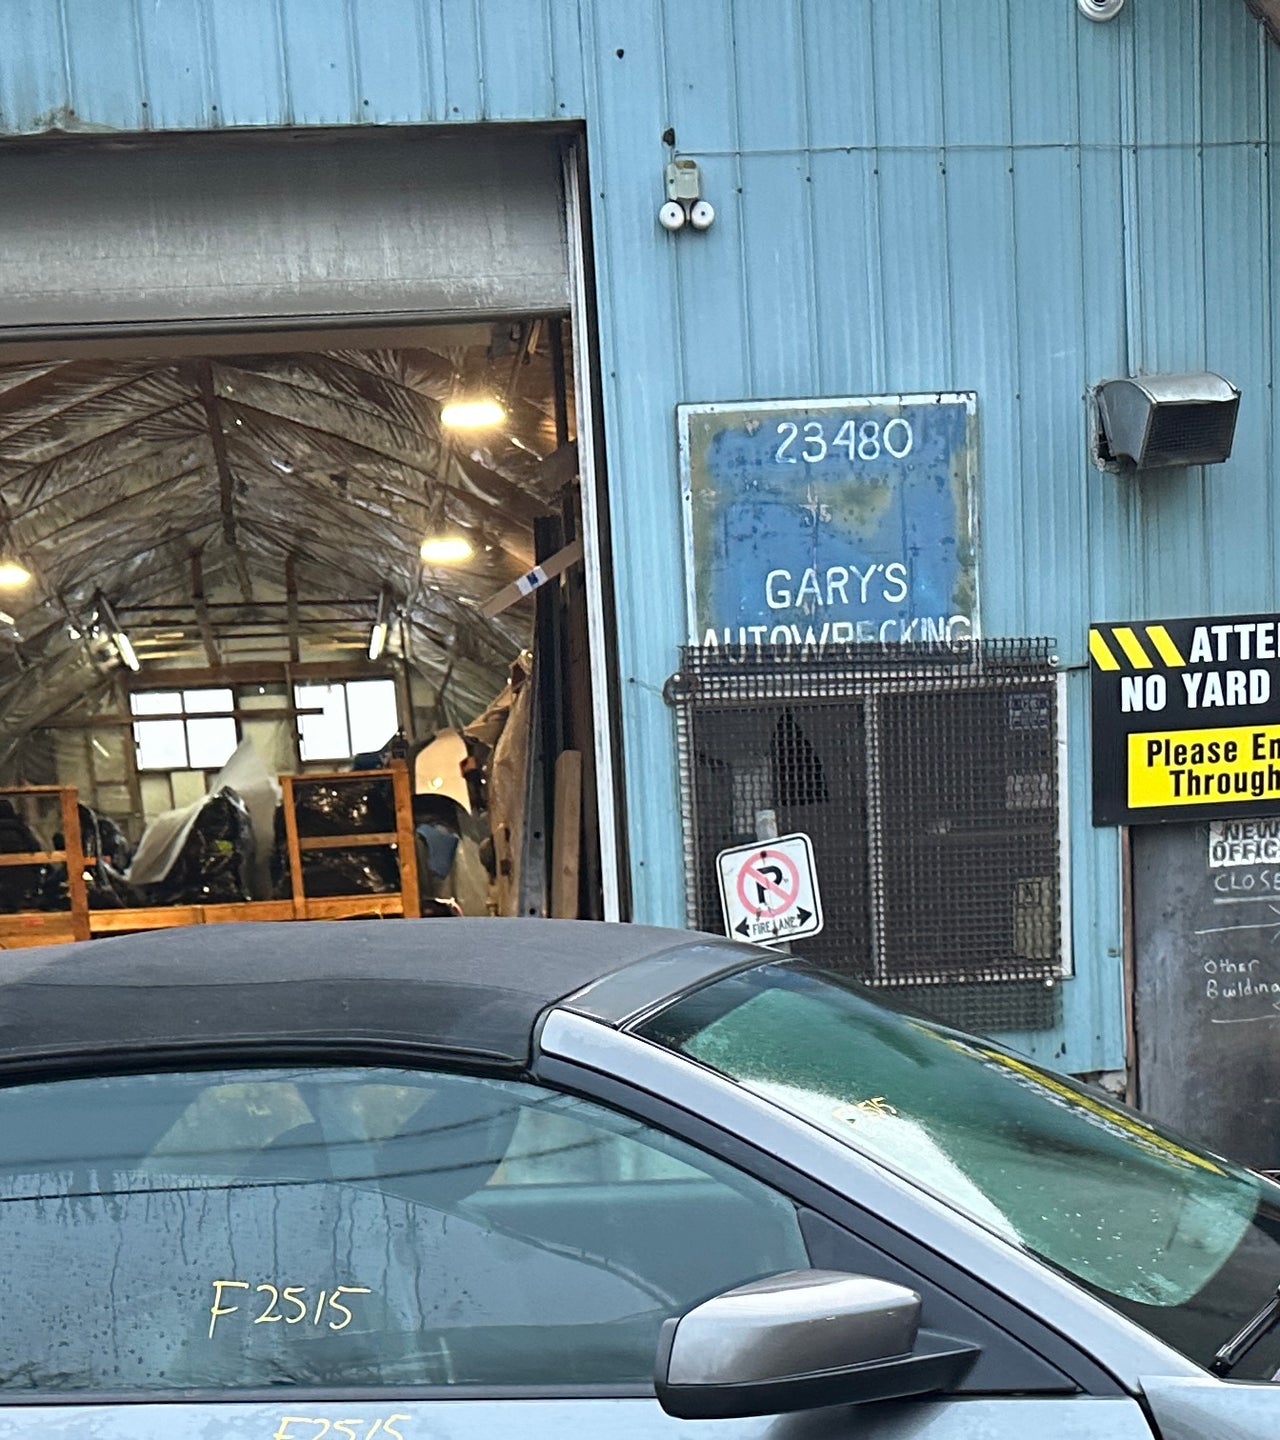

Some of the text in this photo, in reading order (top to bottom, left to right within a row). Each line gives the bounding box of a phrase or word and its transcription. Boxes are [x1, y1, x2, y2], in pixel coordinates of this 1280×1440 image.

[775, 418, 914, 464] 23480
[765, 563, 908, 609] GARY'S
[1120, 675, 1167, 713] NO
[1181, 669, 1271, 709] YARD
[1146, 738, 1238, 768] Please
[1224, 821, 1279, 841] NEW
[752, 921, 771, 935] FIRE
[1204, 958, 1260, 975] Other
[208, 1280, 372, 1339] F2515
